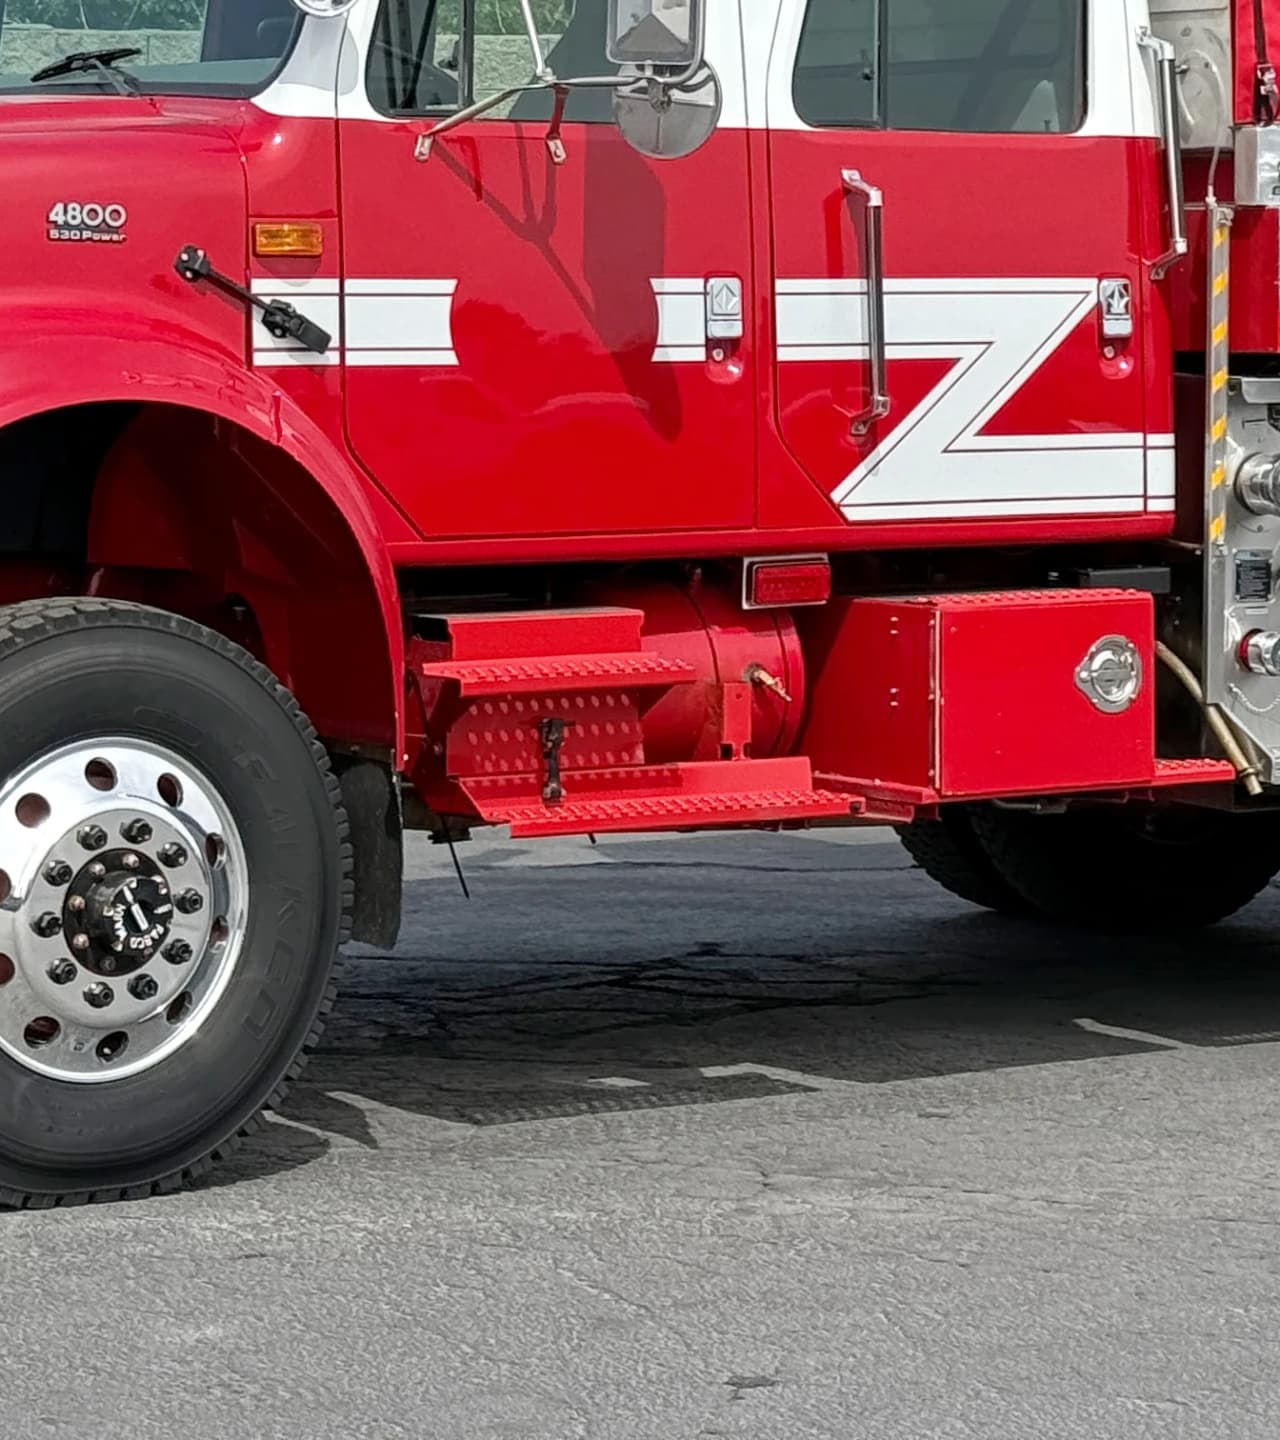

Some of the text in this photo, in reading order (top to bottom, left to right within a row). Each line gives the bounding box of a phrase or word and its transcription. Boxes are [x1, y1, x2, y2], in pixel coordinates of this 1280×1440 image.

[48, 202, 127, 228] 4800
[49, 229, 128, 242] 530 Power
